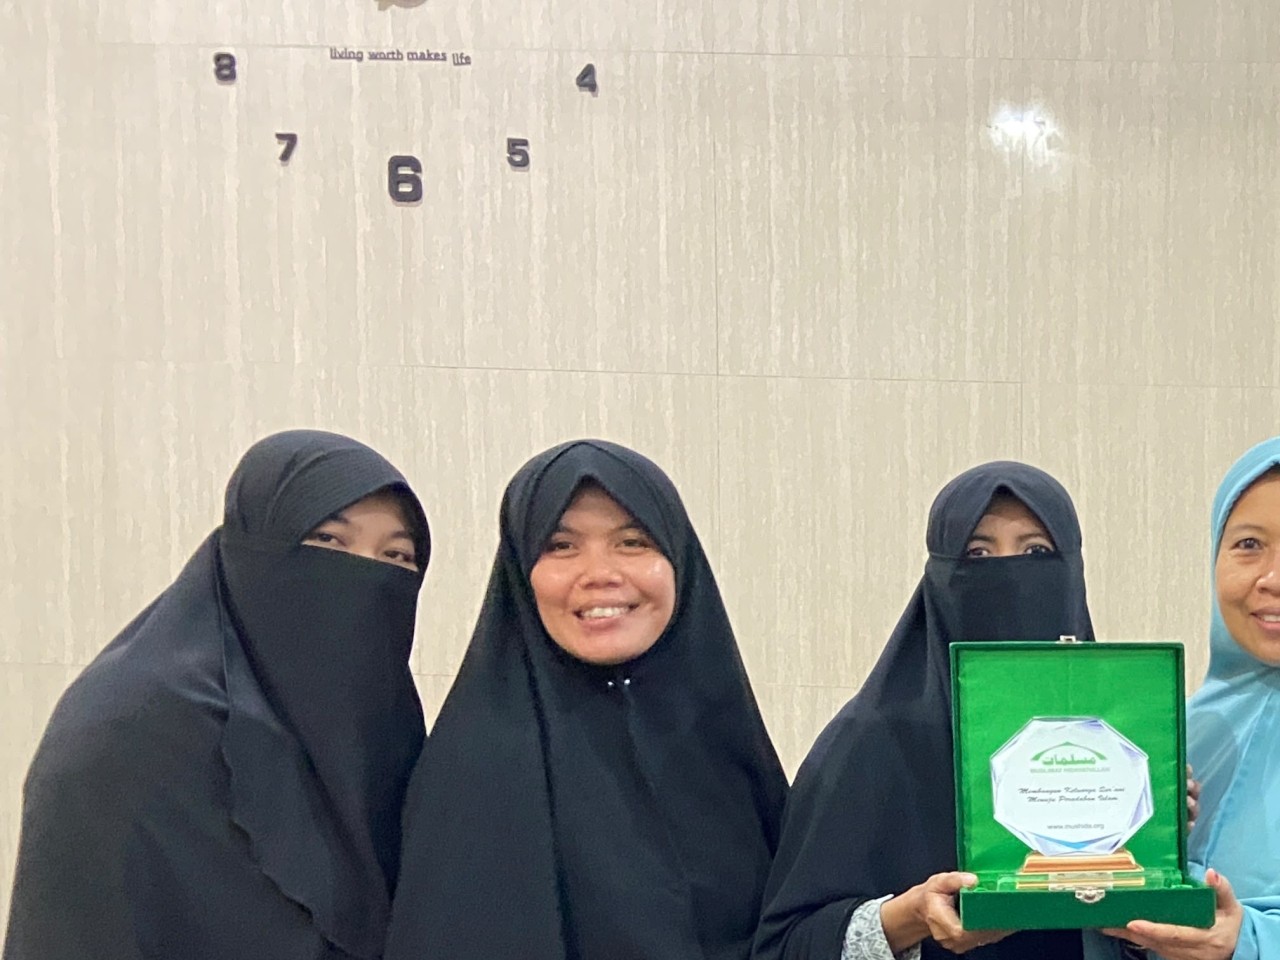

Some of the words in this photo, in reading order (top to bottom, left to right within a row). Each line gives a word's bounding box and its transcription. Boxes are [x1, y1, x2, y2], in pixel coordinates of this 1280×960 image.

[213, 53, 237, 82] 8
[329, 46, 364, 62] living
[368, 48, 404, 61] worth
[407, 49, 447, 62] makes
[452, 53, 472, 66] life
[576, 63, 598, 93] 4
[275, 132, 298, 162] 7
[507, 138, 530, 168] 5
[388, 155, 423, 203] 6
